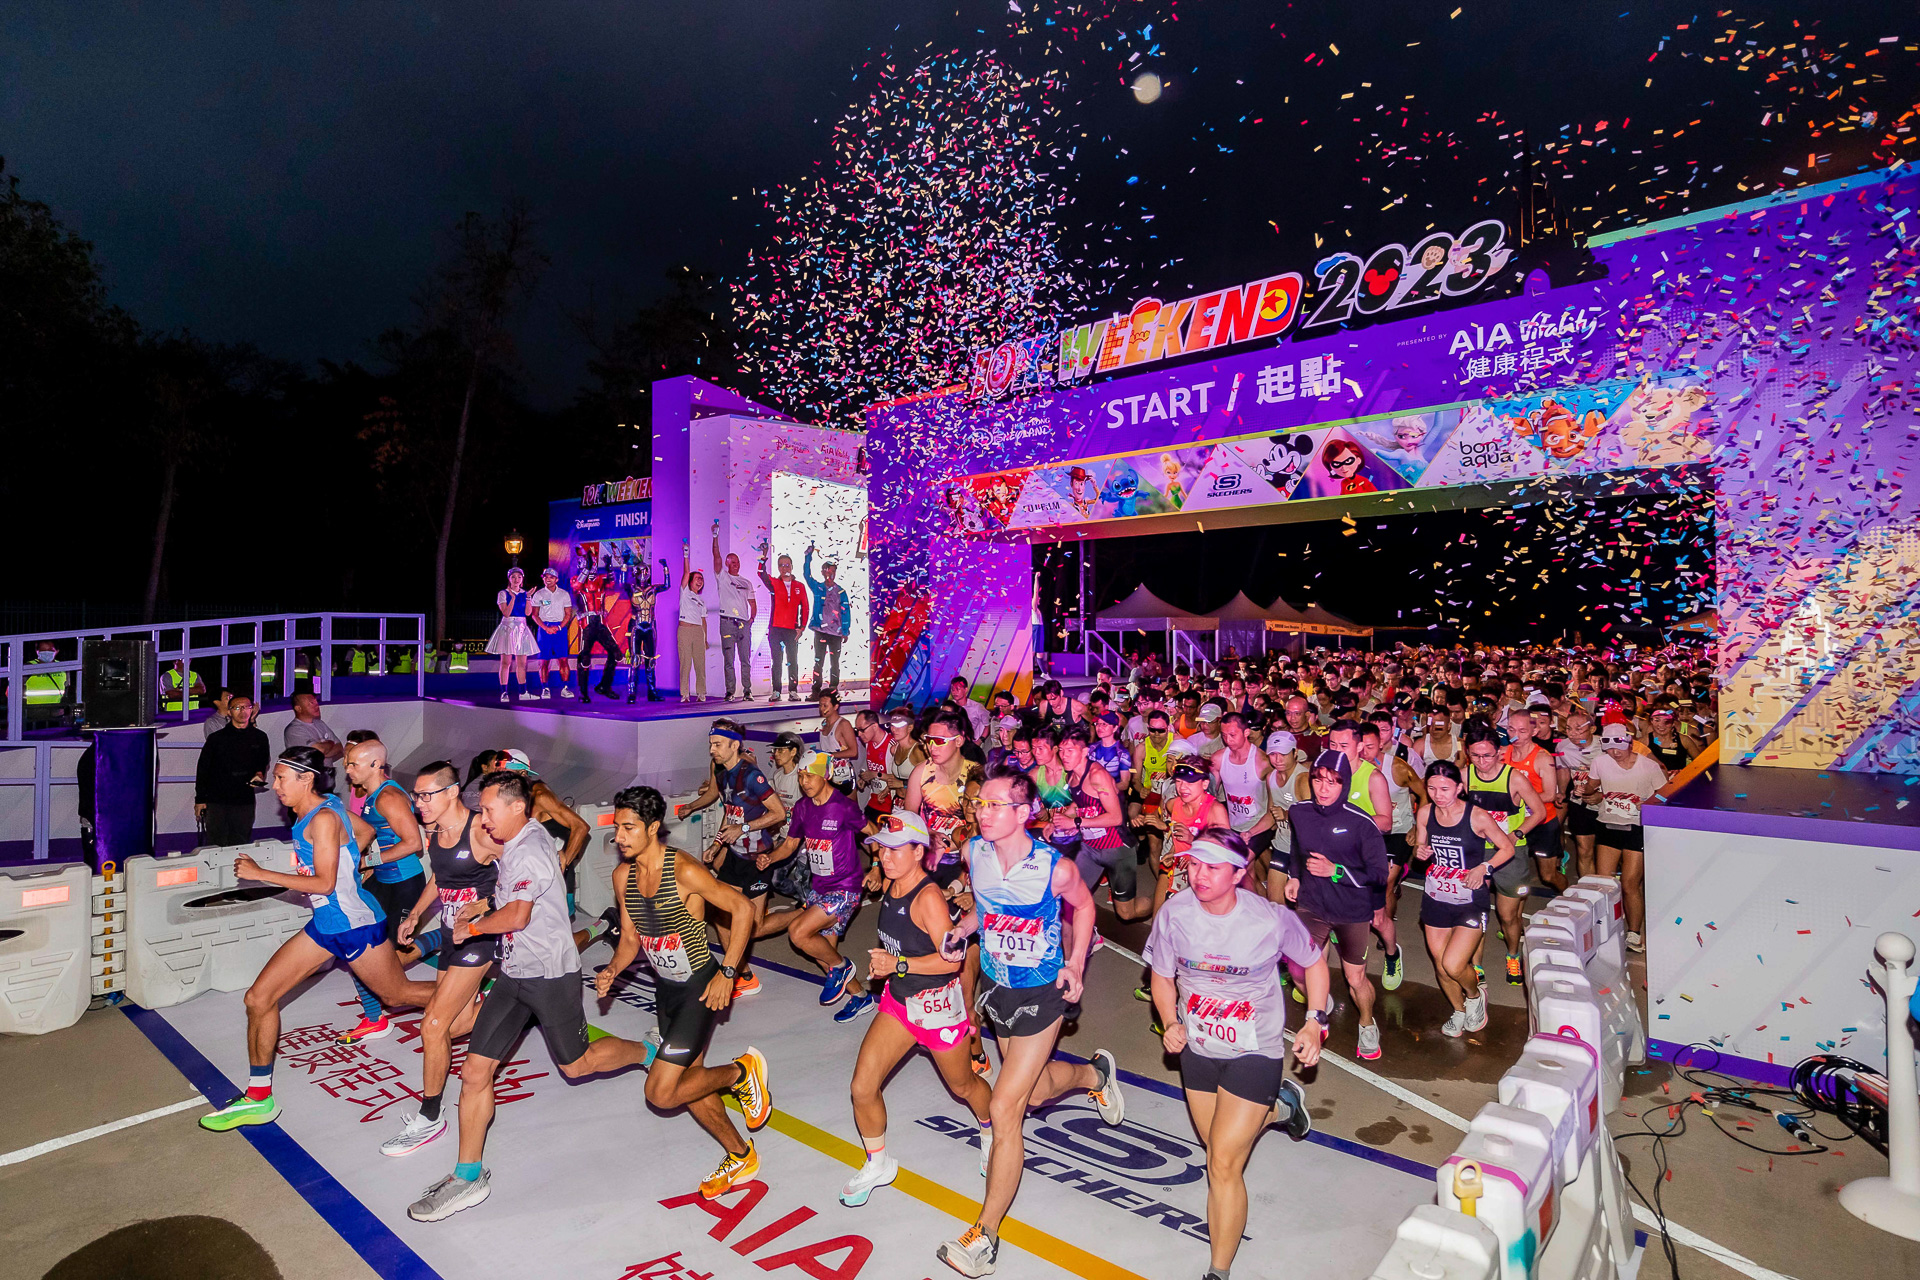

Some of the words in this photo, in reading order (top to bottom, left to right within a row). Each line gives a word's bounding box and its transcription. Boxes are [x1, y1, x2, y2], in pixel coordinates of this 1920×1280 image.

[1058, 272, 1303, 381] WEEKEND
[1302, 219, 1507, 330] 2023
[1396, 335, 1436, 347] PRESENTED
[1449, 322, 1513, 355] AIA
[1466, 340, 1574, 381] 健康程式
[1107, 381, 1215, 429] START
[1256, 353, 1342, 405] 起點
[1460, 440, 1498, 455] bon
[1462, 452, 1513, 468] aqua
[1207, 488, 1252, 498] SKECHERS
[615, 511, 648, 527] FINISH
[1436, 848, 1459, 858] NB
[1436, 880, 1458, 894] 231
[996, 934, 1035, 952] 7017
[923, 997, 952, 1014] 654
[1204, 1022, 1237, 1043] 700
[914, 1115, 1252, 1244] SKCHERS
[657, 1179, 874, 1280] AIA
